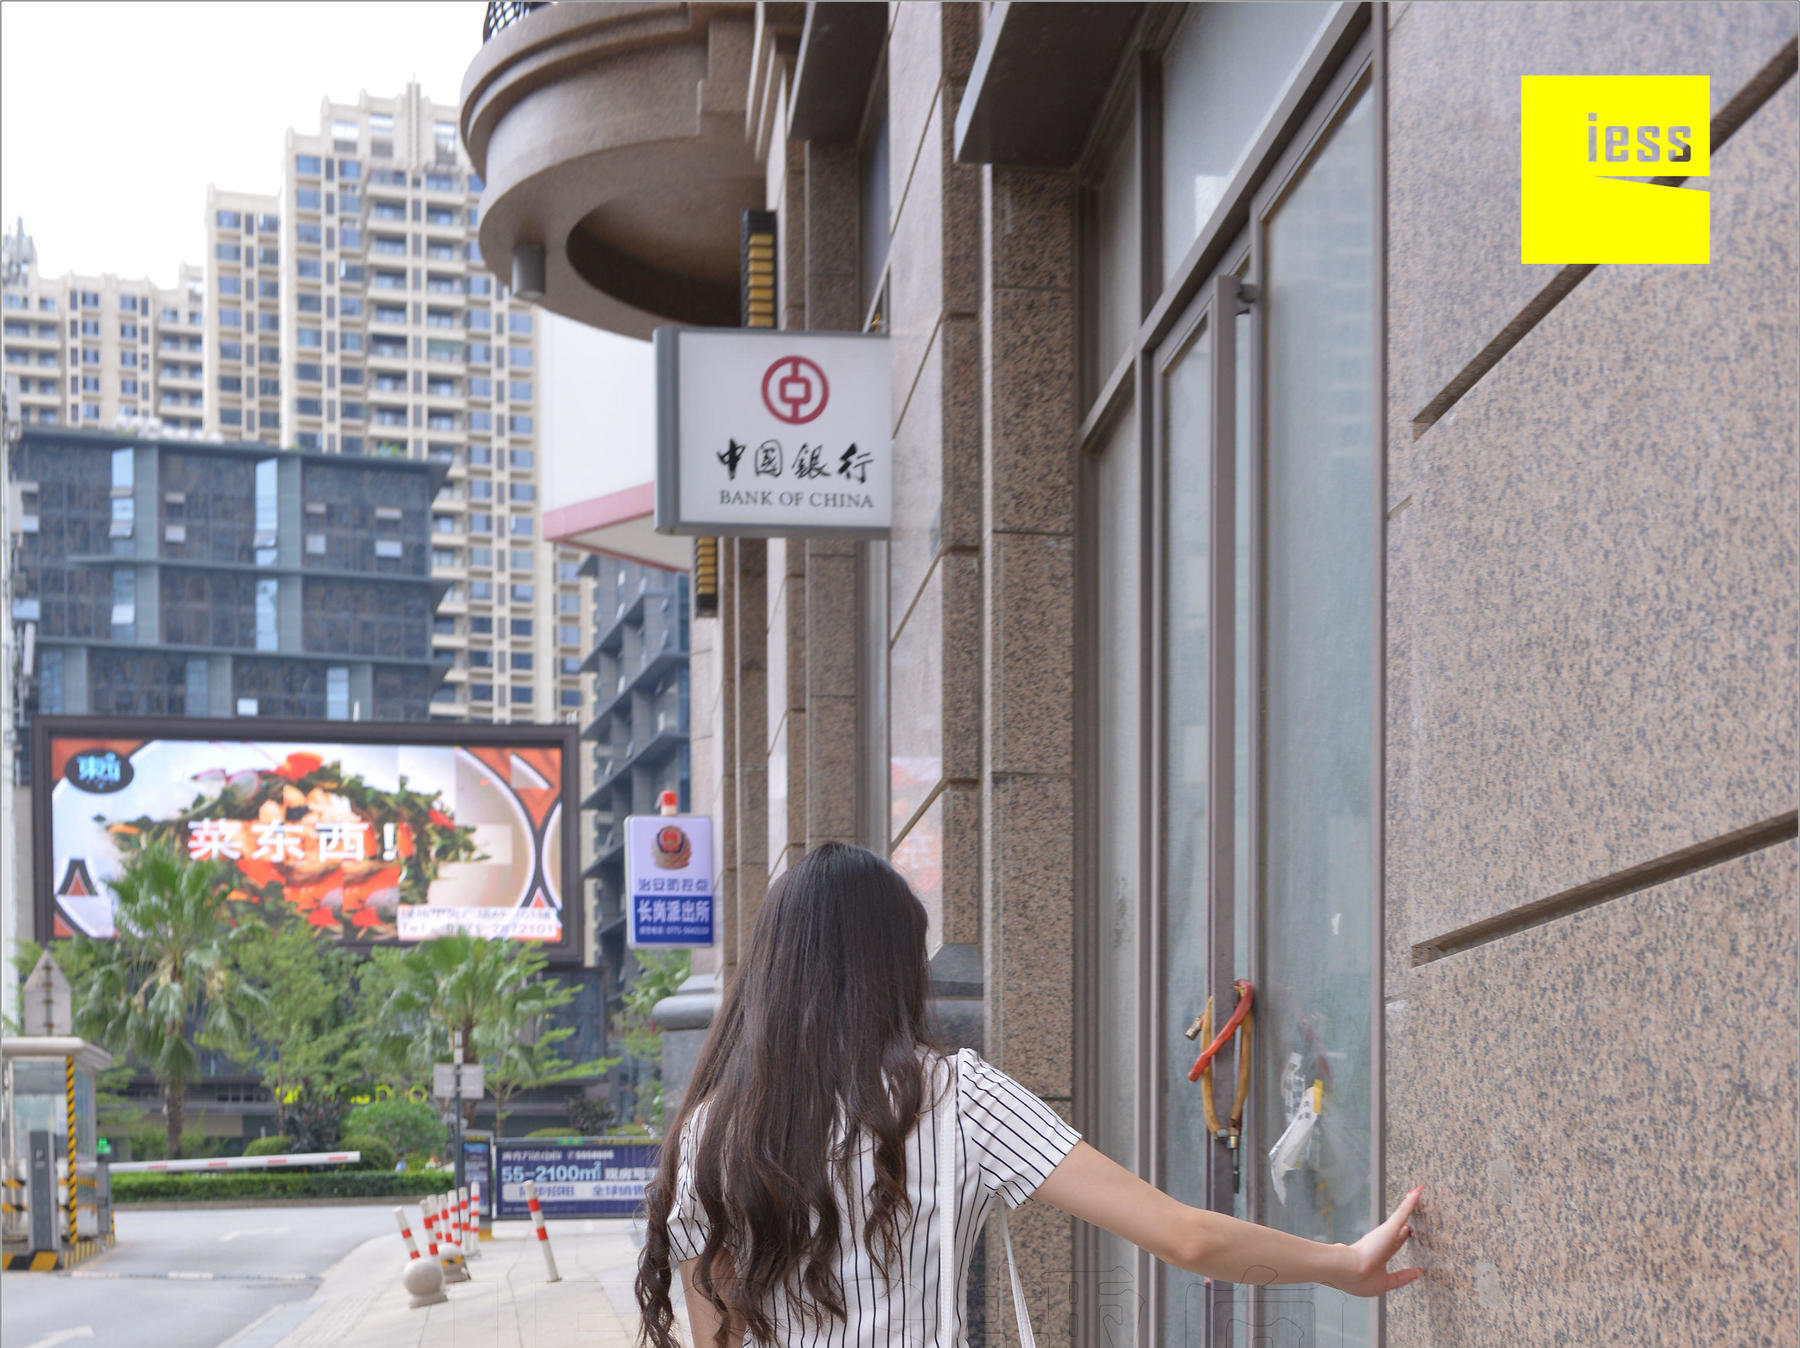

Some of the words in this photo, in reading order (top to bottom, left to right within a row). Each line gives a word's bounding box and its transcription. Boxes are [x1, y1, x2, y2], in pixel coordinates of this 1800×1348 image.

[719, 489, 774, 506] BANK
[779, 490, 804, 507] OF
[808, 491, 875, 509] CHINA
[637, 899, 711, 923] 长岗派出所
